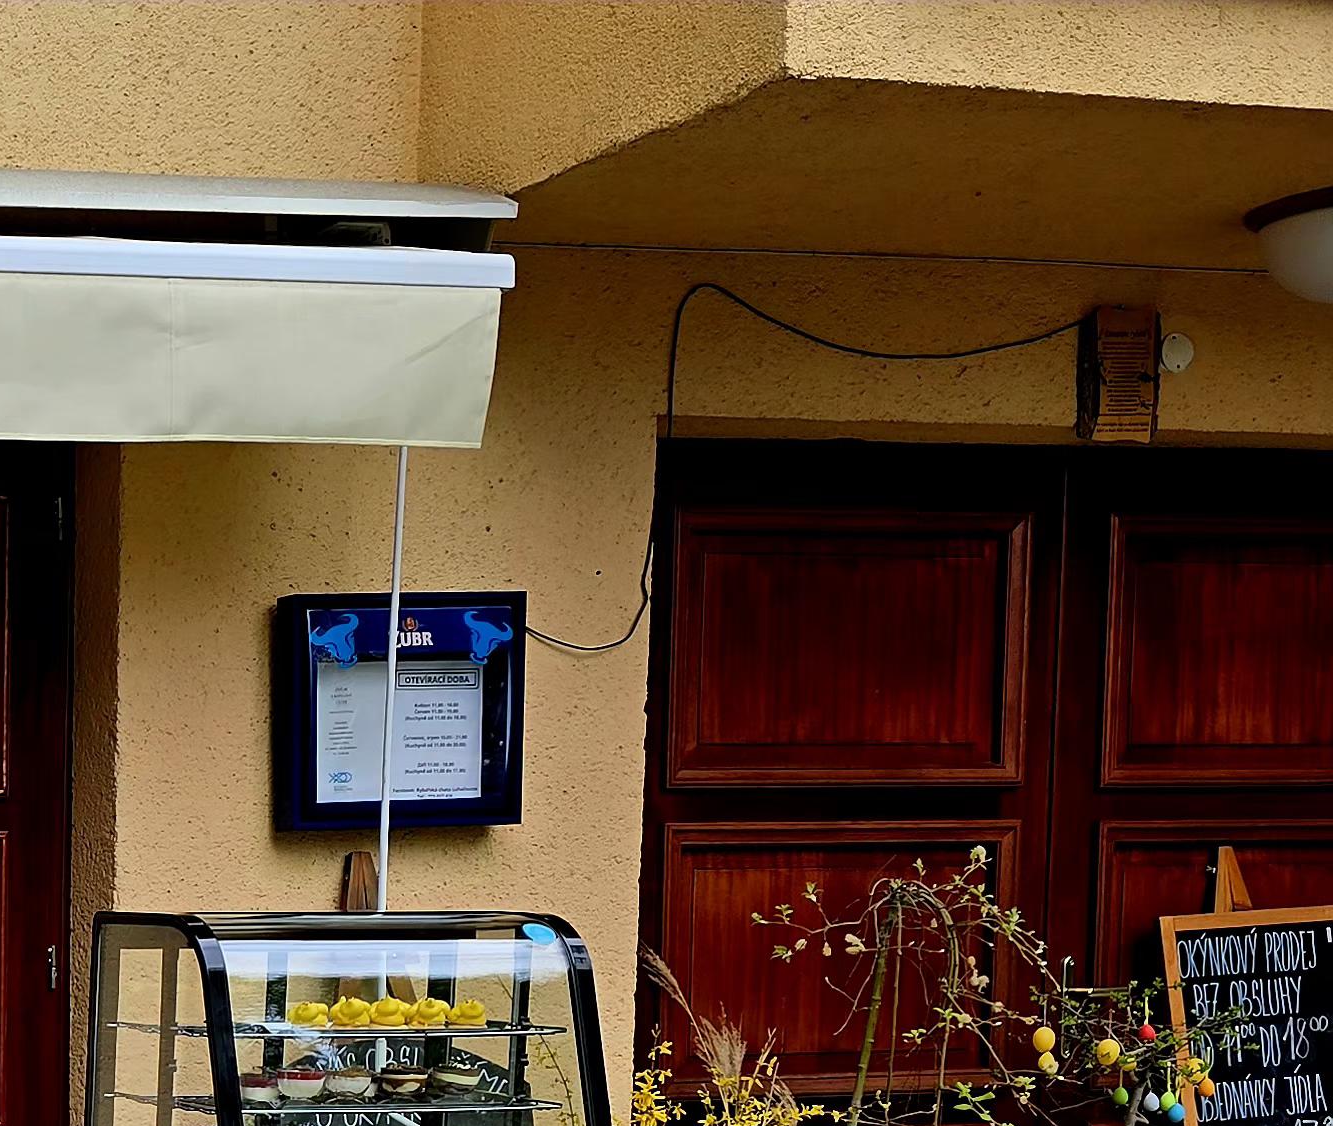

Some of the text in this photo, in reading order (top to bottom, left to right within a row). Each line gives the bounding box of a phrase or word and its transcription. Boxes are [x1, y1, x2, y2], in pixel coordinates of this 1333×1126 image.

[1177, 928, 1317, 978] OKÝNKOVÝ PRODEJ
[1230, 976, 1301, 1017] OBSLUHY
[1260, 1025, 1281, 1067] DO
[1284, 1064, 1327, 1115] JÍDLA
